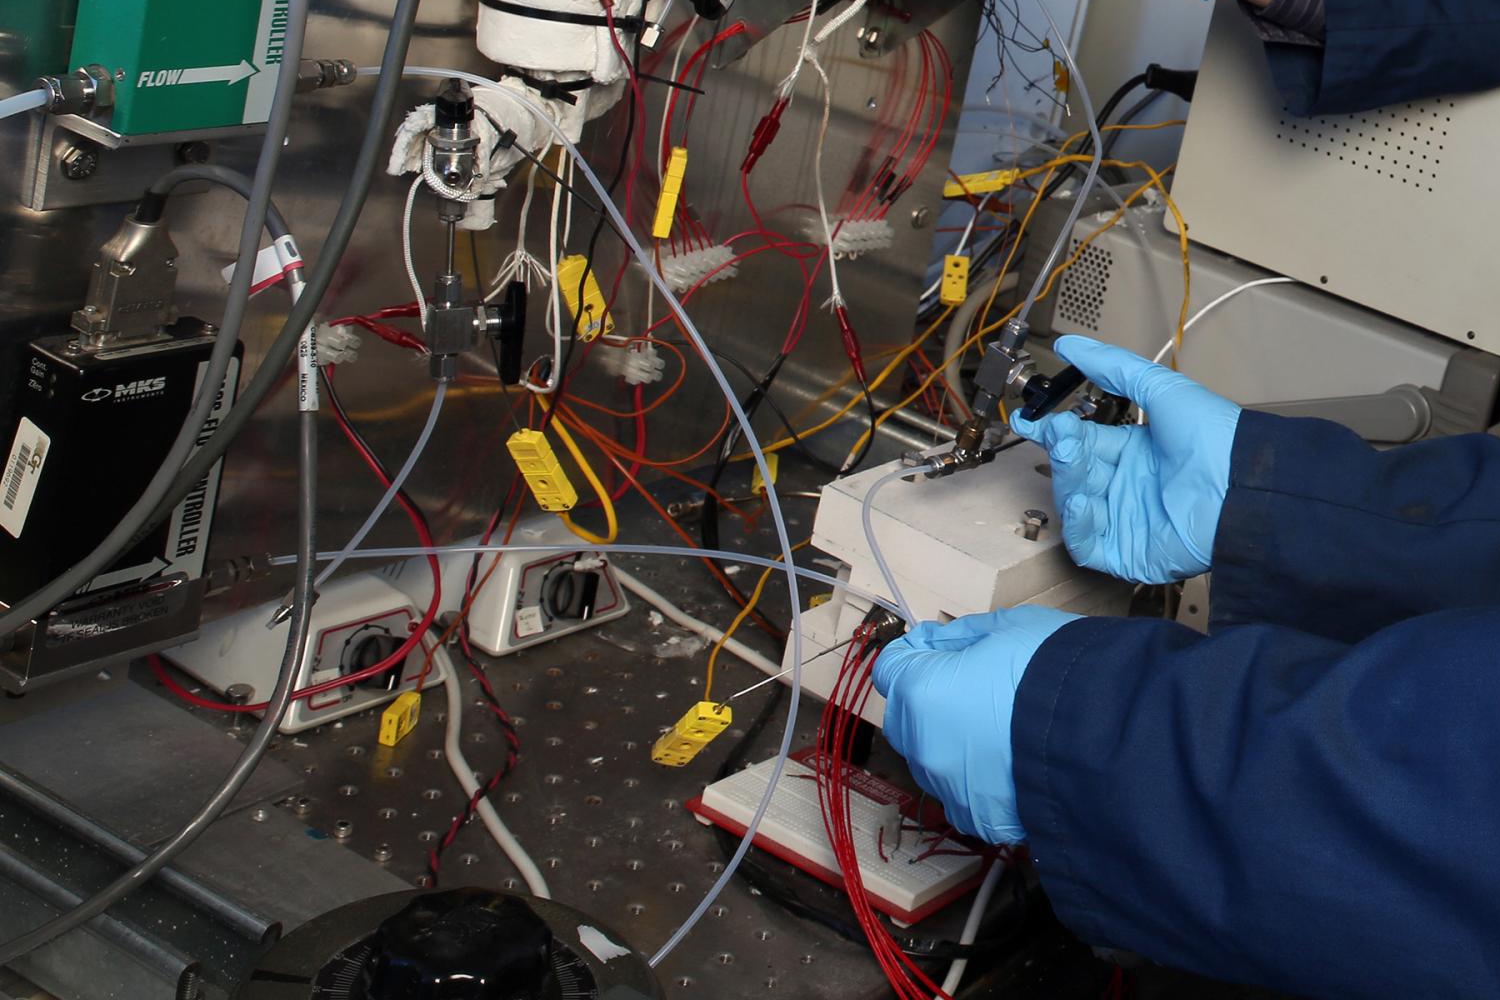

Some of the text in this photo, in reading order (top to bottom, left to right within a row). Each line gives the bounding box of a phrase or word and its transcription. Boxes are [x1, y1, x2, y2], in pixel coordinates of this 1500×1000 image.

[137, 69, 182, 88] FLOW
[114, 376, 167, 398] MKS
[300, 373, 309, 402] MEXICO
